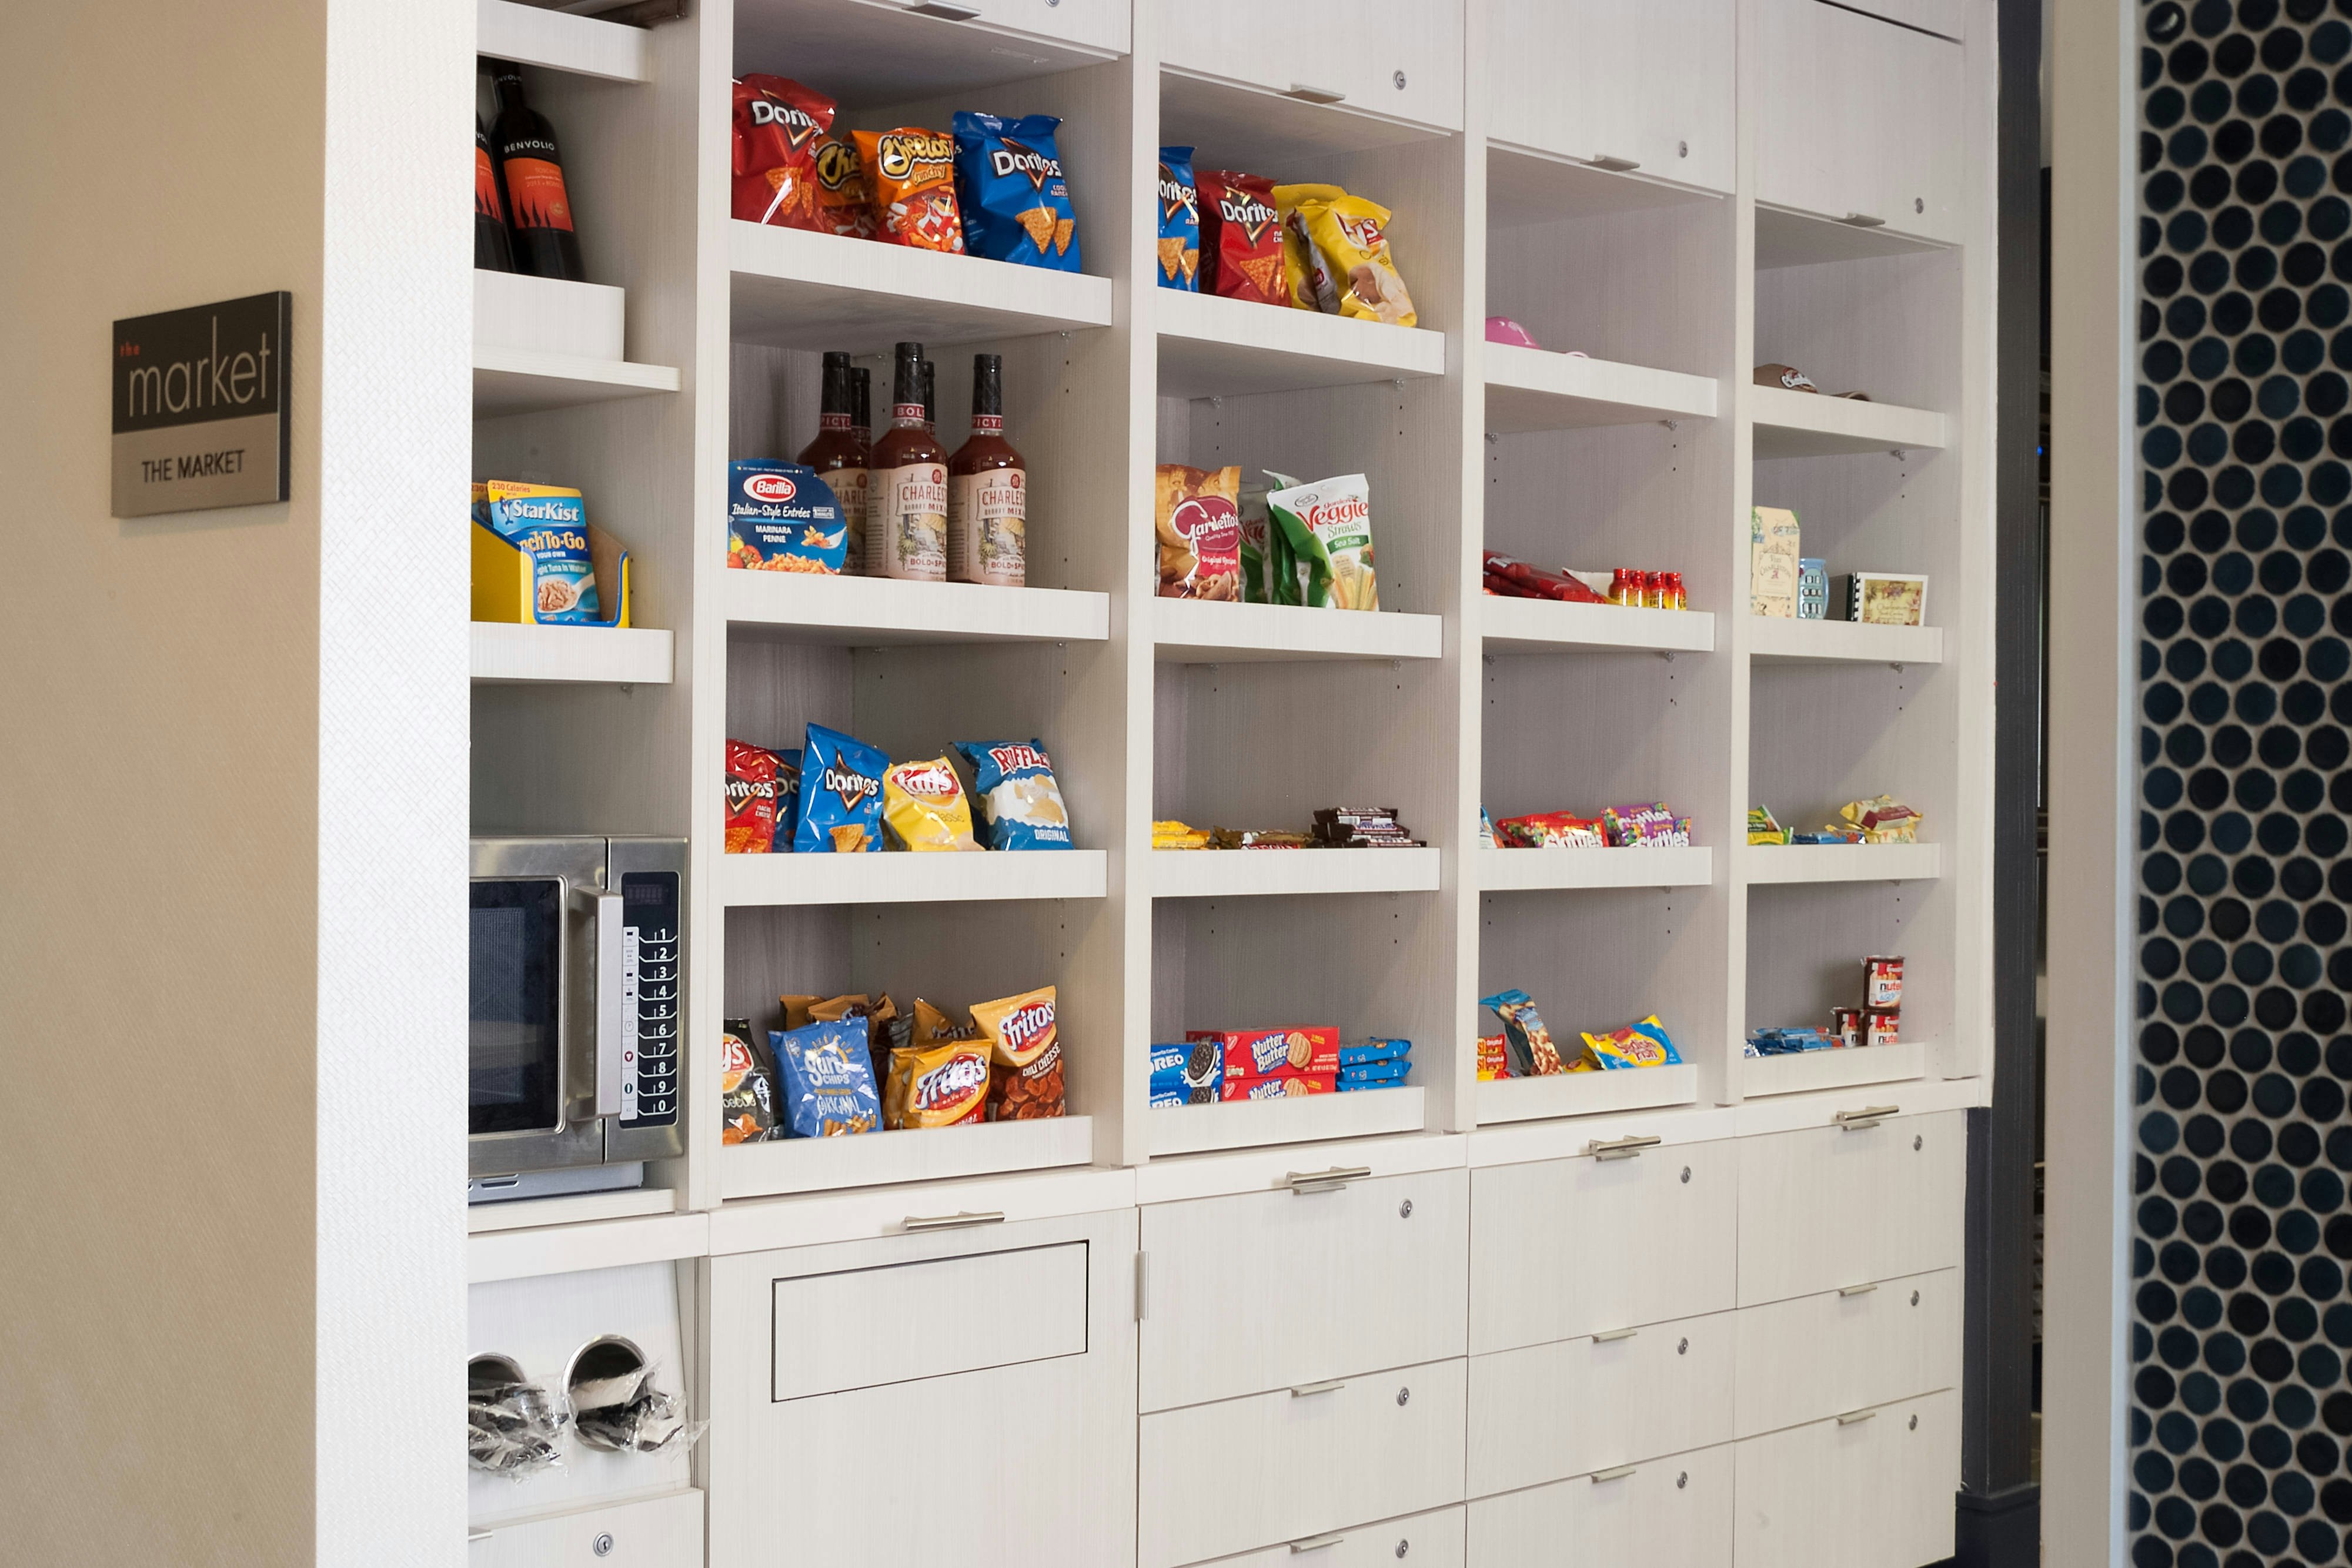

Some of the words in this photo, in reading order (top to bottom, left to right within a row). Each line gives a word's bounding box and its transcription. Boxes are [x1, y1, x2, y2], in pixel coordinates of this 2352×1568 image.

[504, 140, 555, 153] BENVOLIO
[883, 135, 951, 176] Cheetos
[993, 151, 1062, 176] Doritos
[911, 163, 946, 185] Crunchy
[1220, 200, 1279, 223] Doritos
[129, 315, 271, 417] market
[897, 407, 924, 417] BOL
[142, 458, 172, 483] THE
[178, 449, 245, 479] MARKET
[492, 482, 505, 490] 230
[756, 481, 792, 494] Barilla
[513, 499, 580, 522] StarKist
[731, 503, 781, 520] Italian-Style
[1296, 498, 1368, 532] Veggie
[756, 525, 792, 534] MARINARA
[1327, 521, 1362, 539] Straws
[763, 534, 786, 543] PENNE
[1334, 540, 1347, 549] Sea
[1348, 537, 1361, 545] Salt
[826, 768, 880, 796] Doritos
[725, 781, 774, 798] oritos
[1034, 829, 1069, 842] ORIGINAL
[660, 928, 666, 940] 1
[660, 947, 667, 959] 2
[660, 966, 667, 978] 3
[659, 985, 667, 997] 4
[659, 1005, 666, 1017] 5
[659, 1024, 667, 1036] 6
[998, 1002, 1055, 1052] Fritos
[659, 1043, 666, 1055] 7
[1252, 1032, 1284, 1059] Nutter
[1038, 1041, 1061, 1071] CHEESE
[1257, 1044, 1289, 1073] Butter
[659, 1062, 666, 1074] 8
[823, 1074, 850, 1084] CHIPS
[915, 1055, 987, 1109] Fritos
[659, 1081, 666, 1093] 9
[659, 1100, 666, 1112] 0
